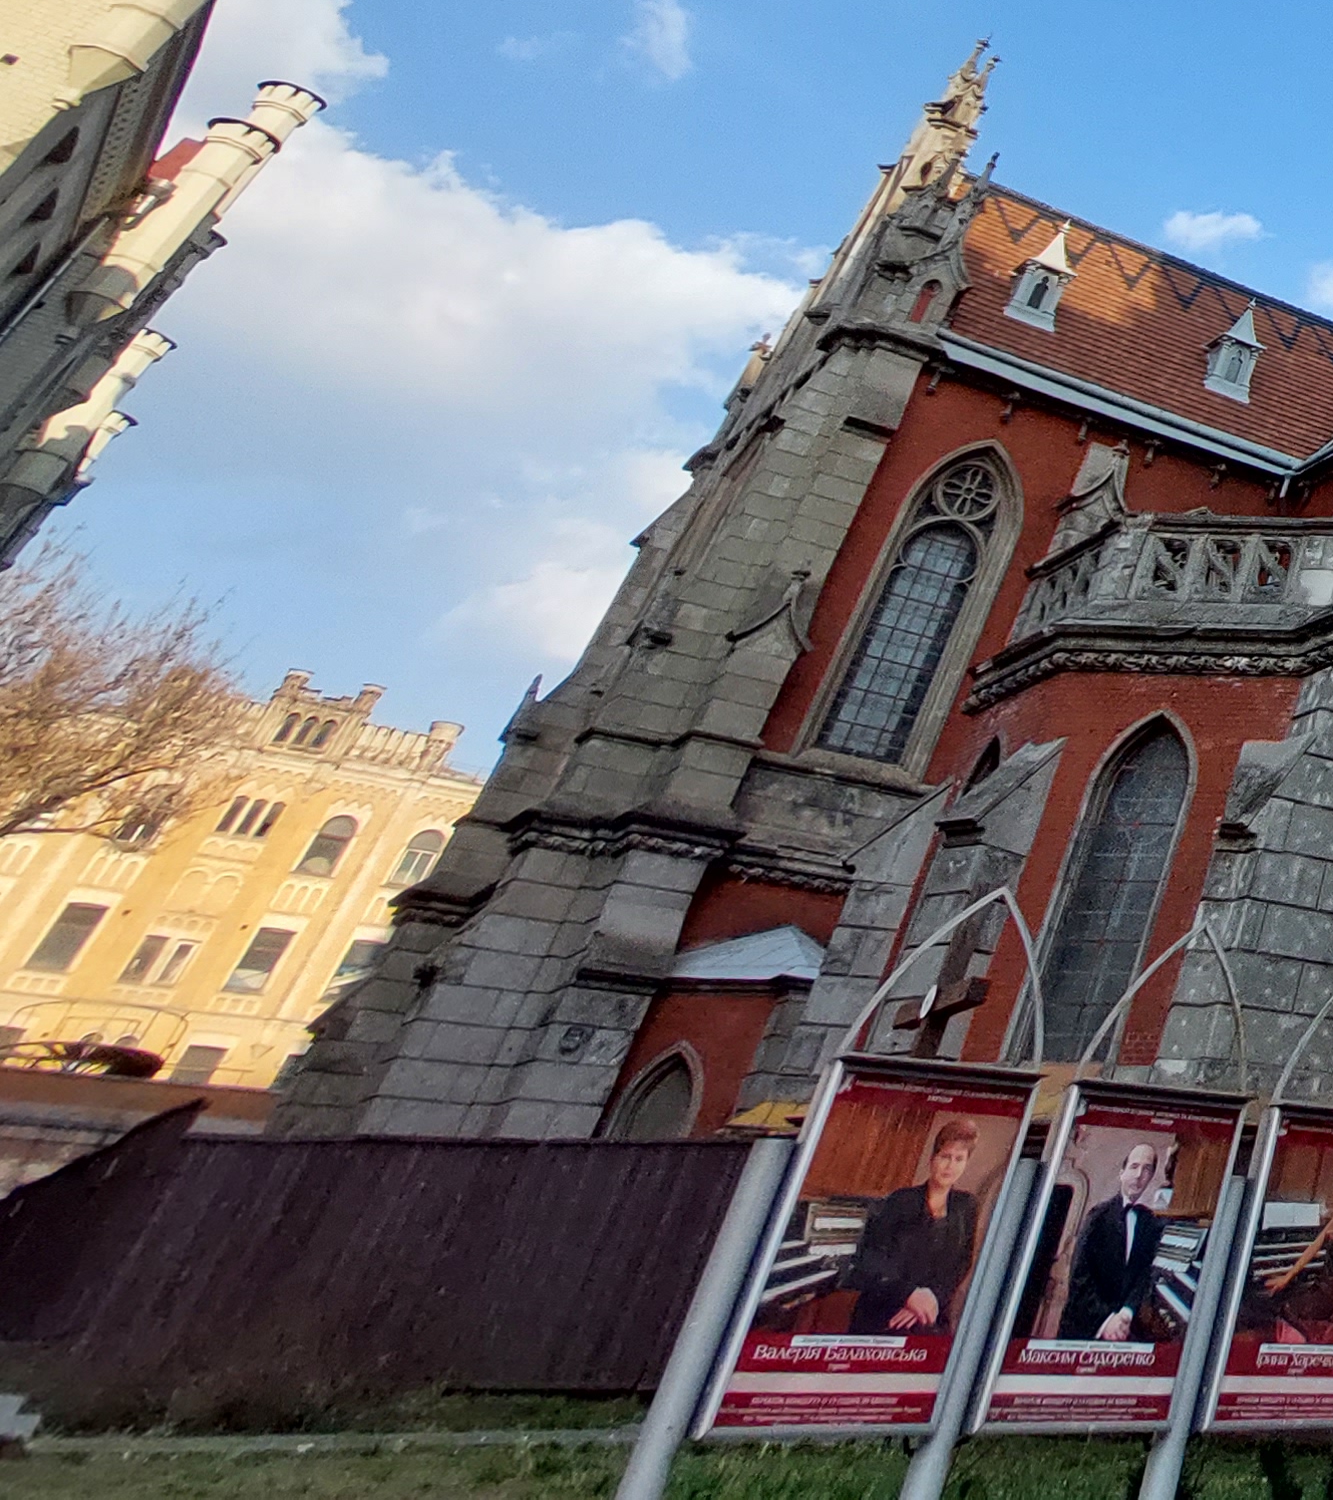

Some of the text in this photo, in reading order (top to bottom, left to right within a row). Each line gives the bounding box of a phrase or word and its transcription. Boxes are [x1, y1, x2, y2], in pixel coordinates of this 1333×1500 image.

[753, 1344, 927, 1363] Валерія Балаховська
[1018, 1348, 1156, 1369] Максим Сидоренко
